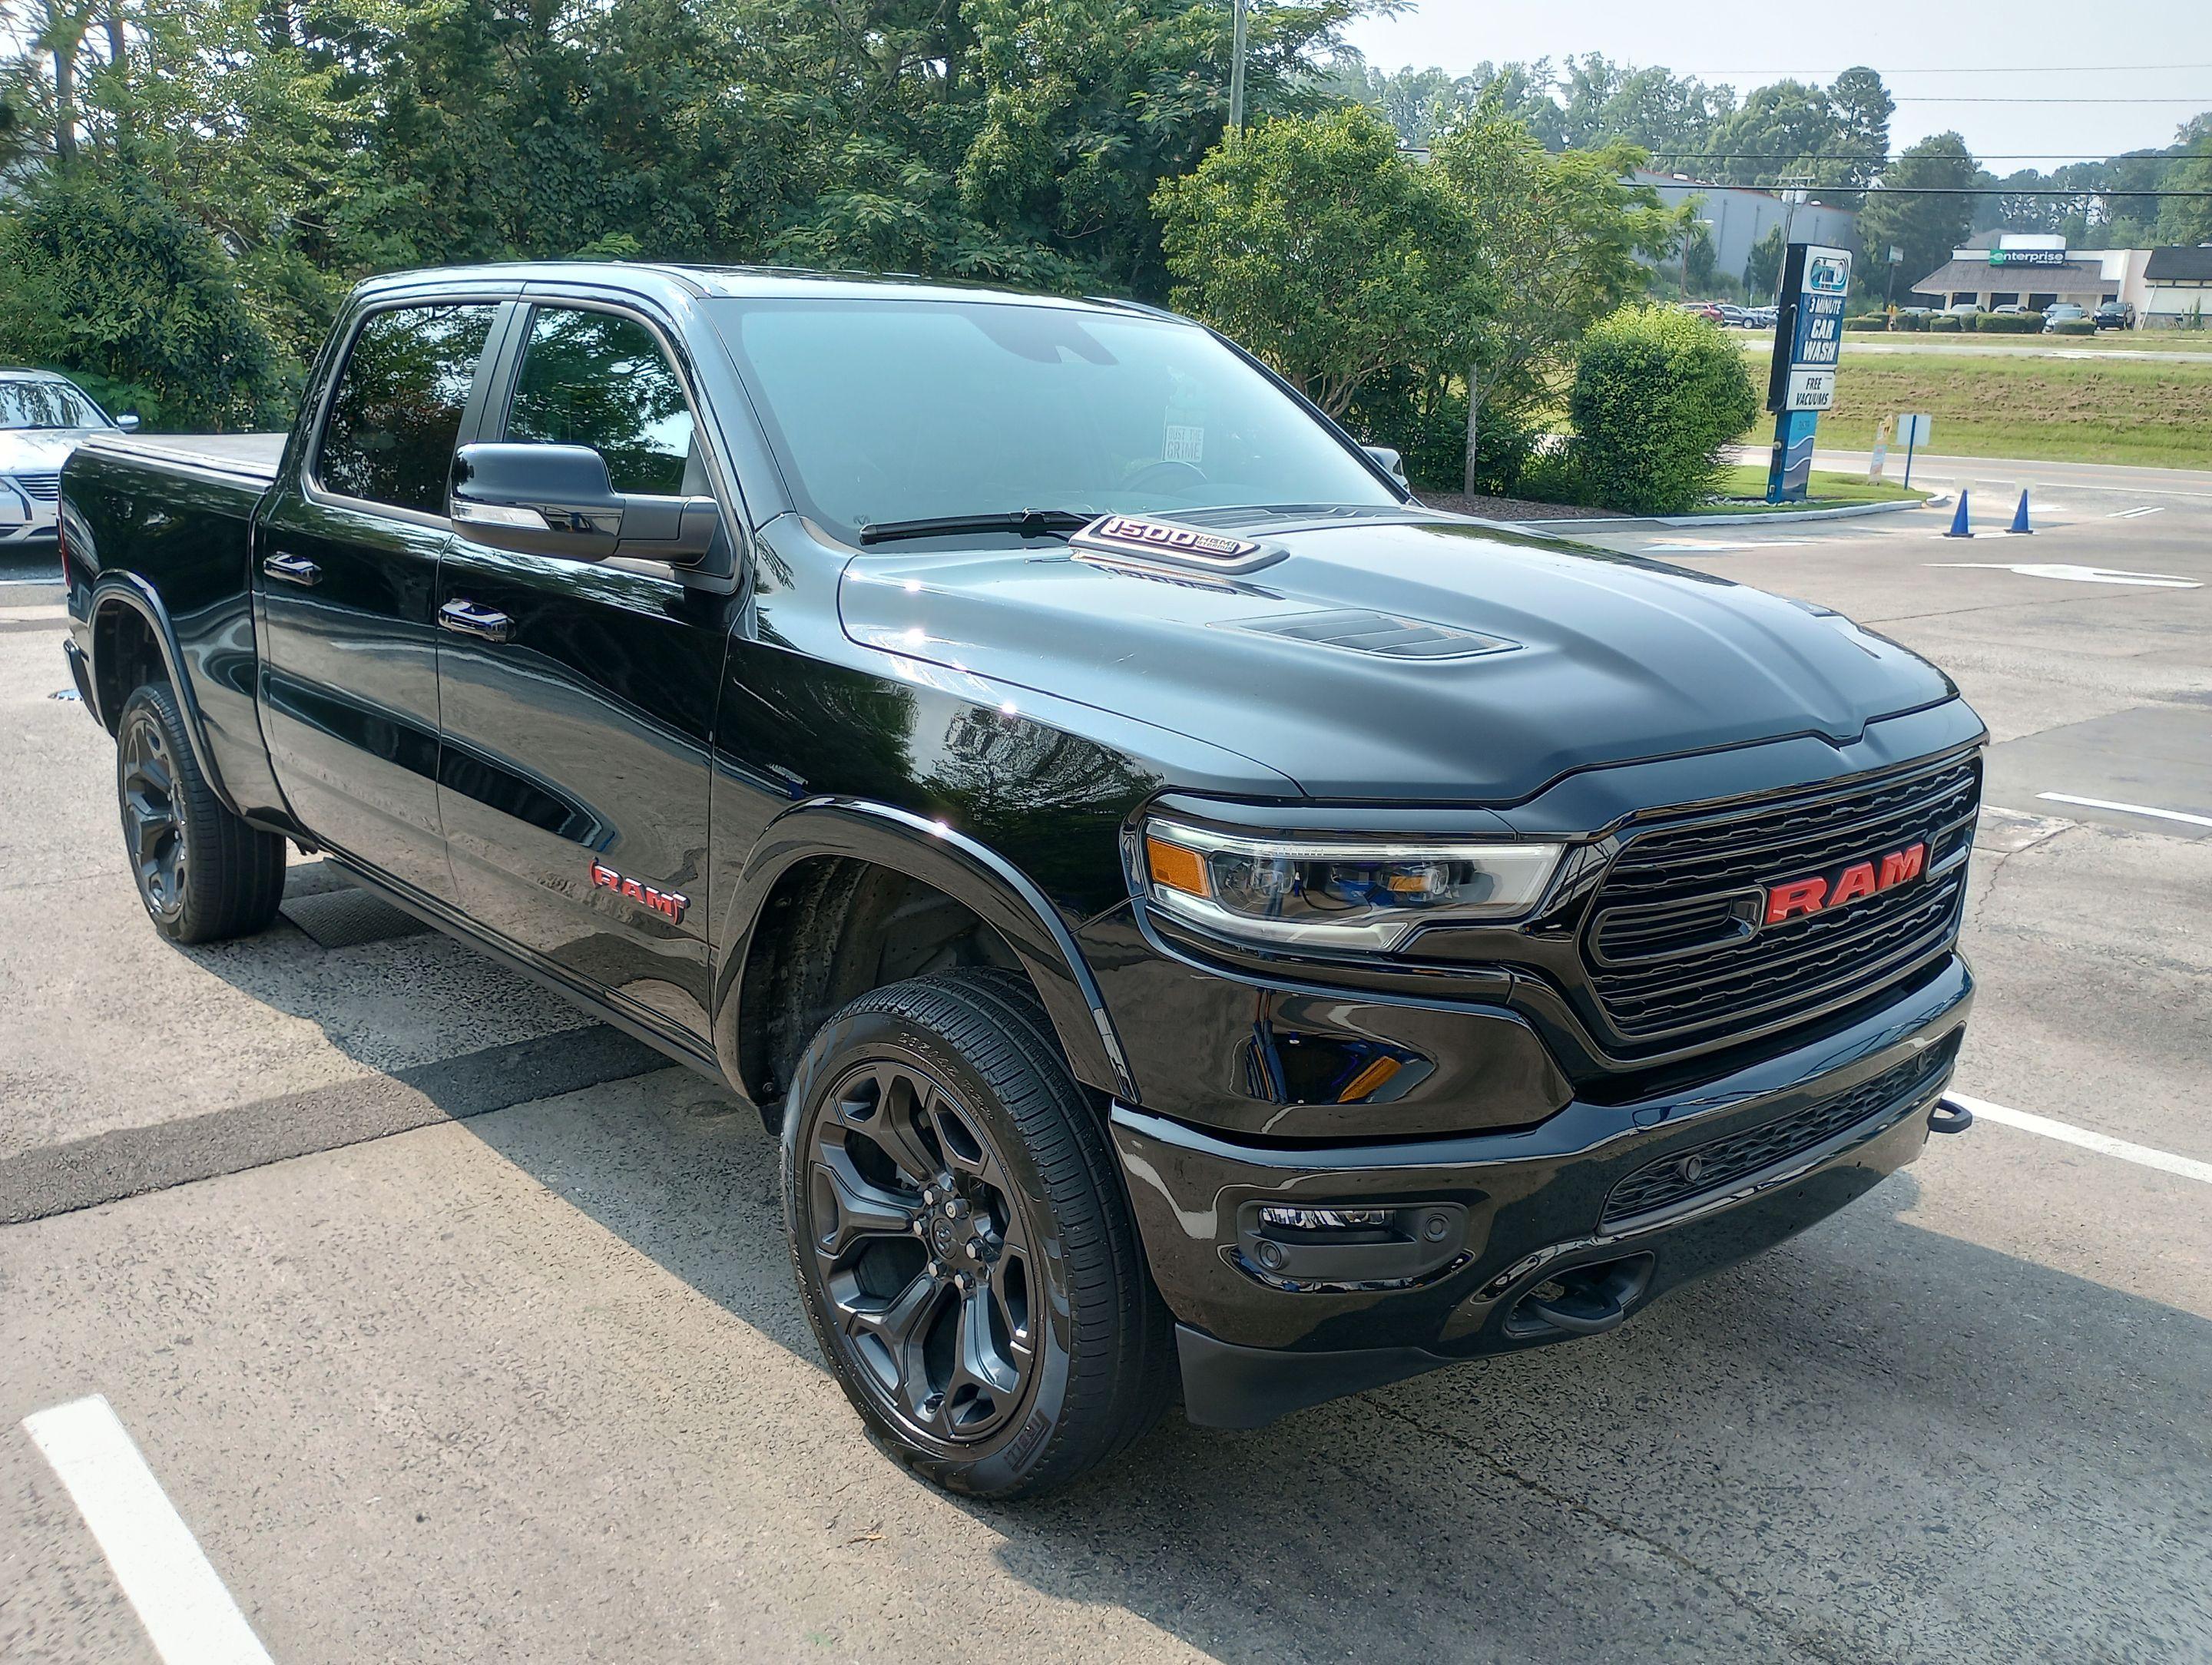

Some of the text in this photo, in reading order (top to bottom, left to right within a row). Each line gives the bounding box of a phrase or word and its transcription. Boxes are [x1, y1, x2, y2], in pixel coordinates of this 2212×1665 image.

[1991, 251, 2064, 263] enterprise
[1809, 297, 1842, 314] 3 MINUTE
[1810, 319, 1835, 339] CAR
[1803, 340, 1836, 362] WASH
[1806, 378, 1822, 389] FREE
[1796, 393, 1829, 405] VACUUMS
[1167, 441, 1201, 459] GRIME
[1108, 520, 1199, 547] 1500
[591, 858, 687, 922] RAM
[1767, 842, 1924, 925] RAM
